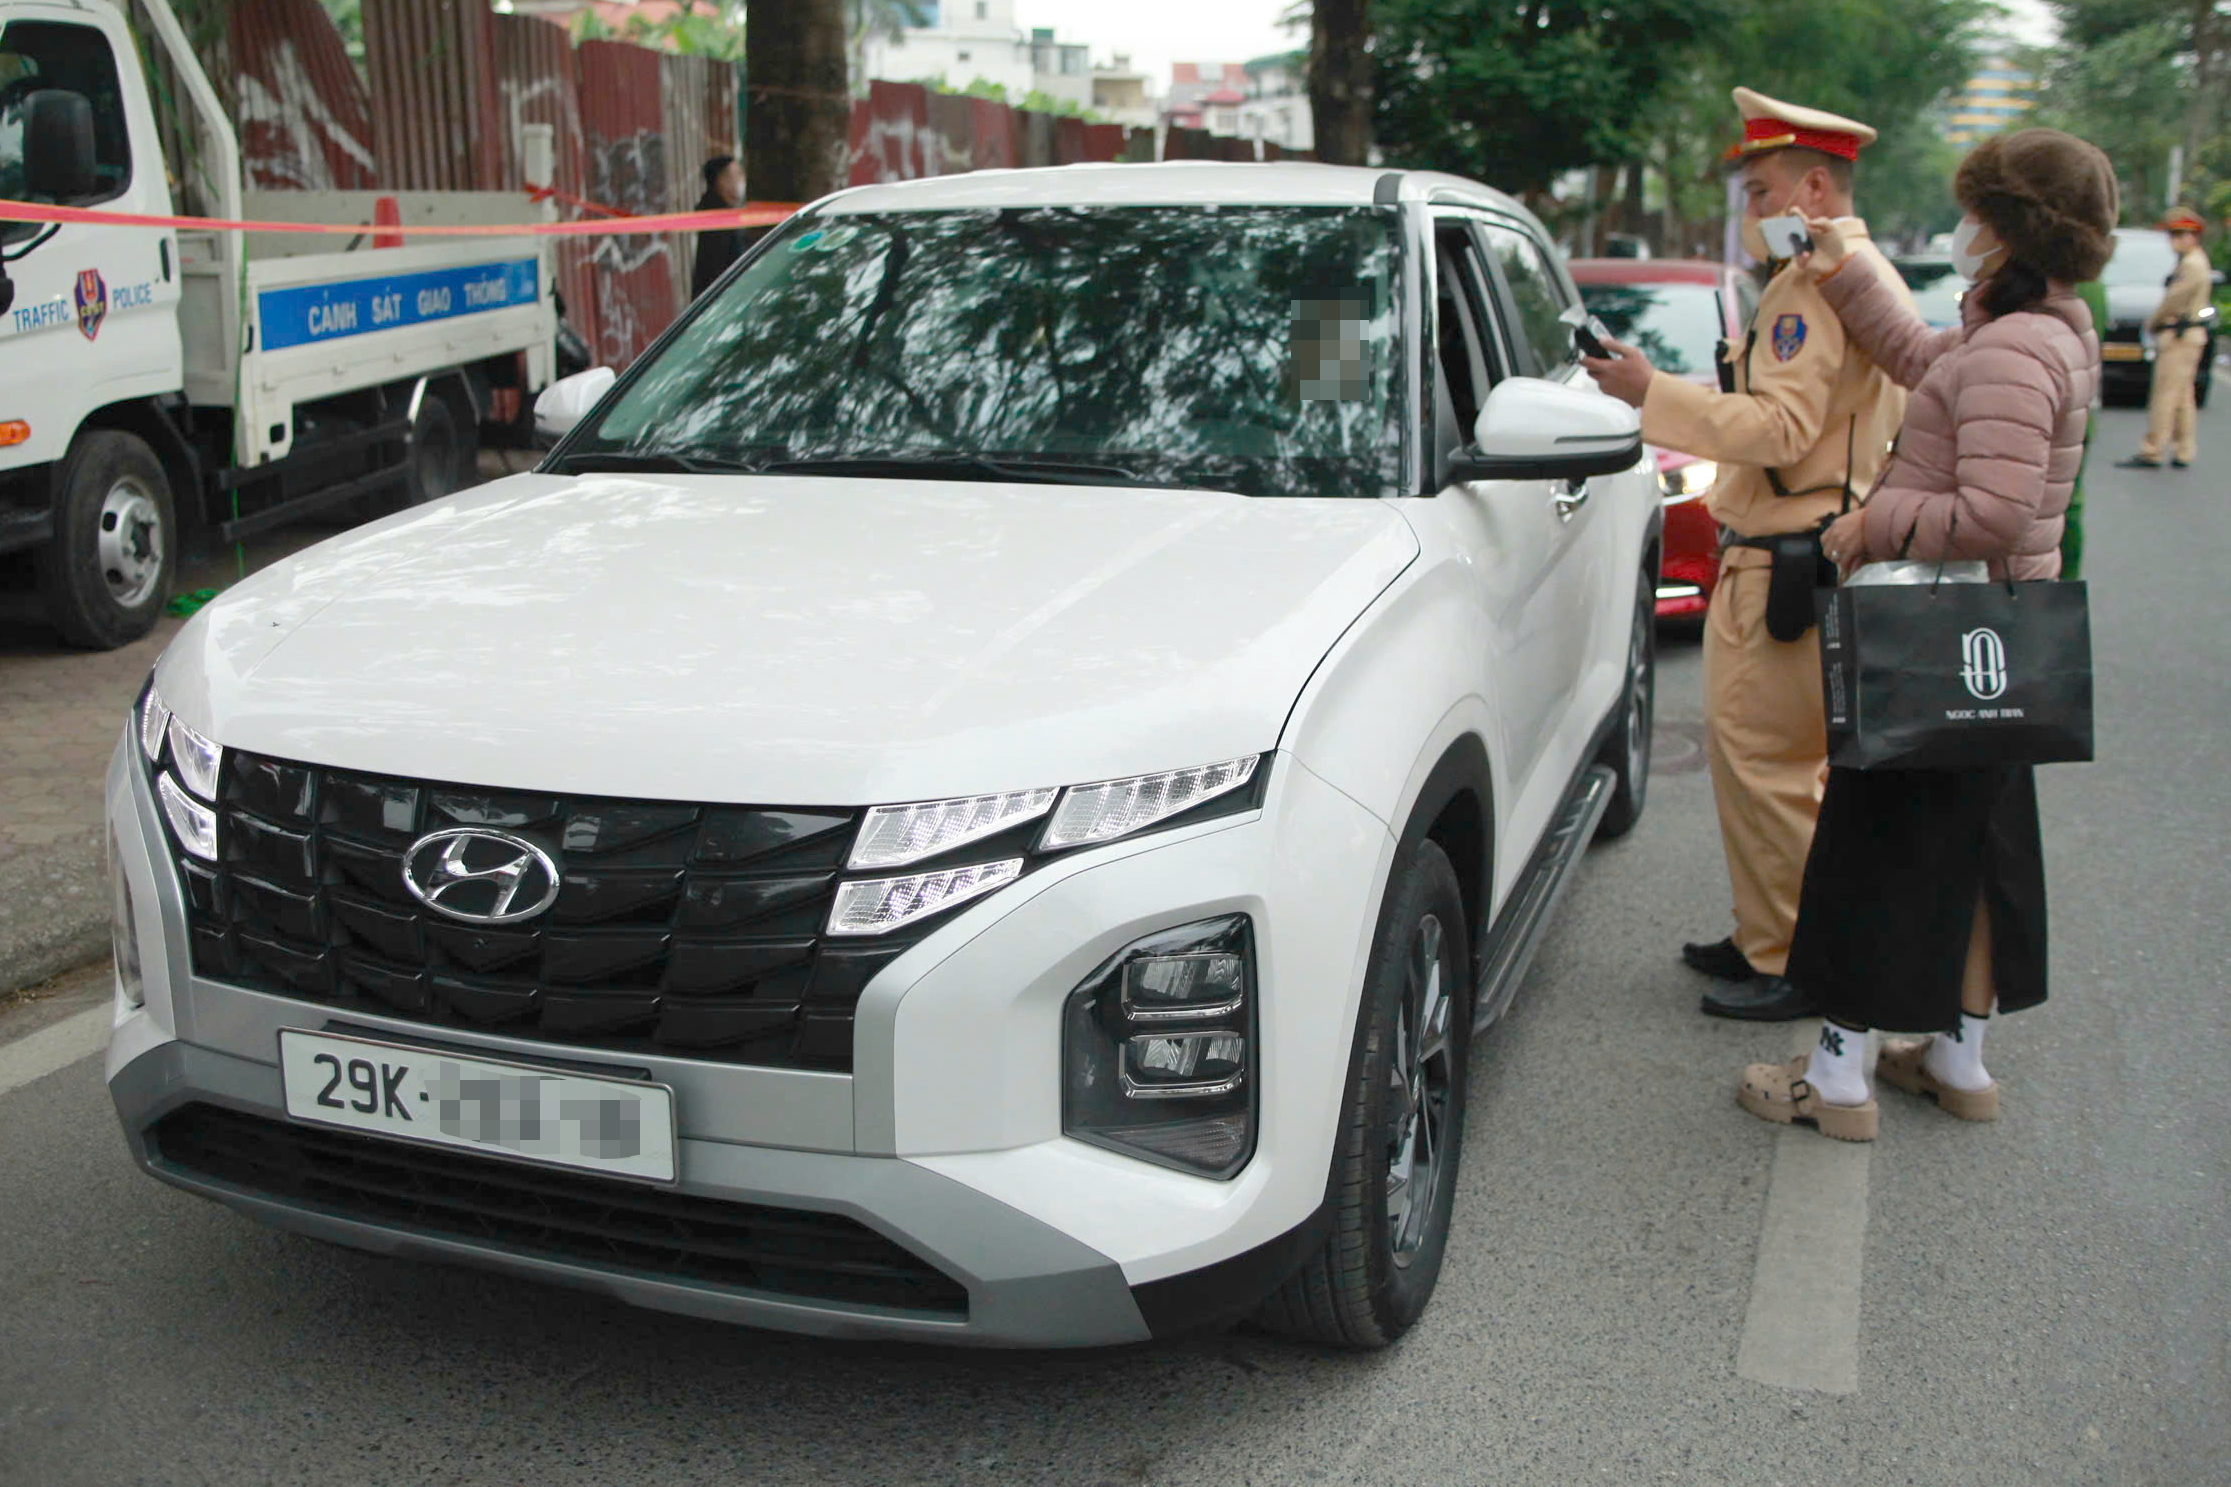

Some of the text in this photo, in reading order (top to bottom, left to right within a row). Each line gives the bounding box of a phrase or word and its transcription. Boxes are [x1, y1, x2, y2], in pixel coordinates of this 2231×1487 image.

[13, 283, 153, 333] TRAFFIC POLICE
[308, 271, 506, 336] CẢNH SÁT GIAO THÔNG
